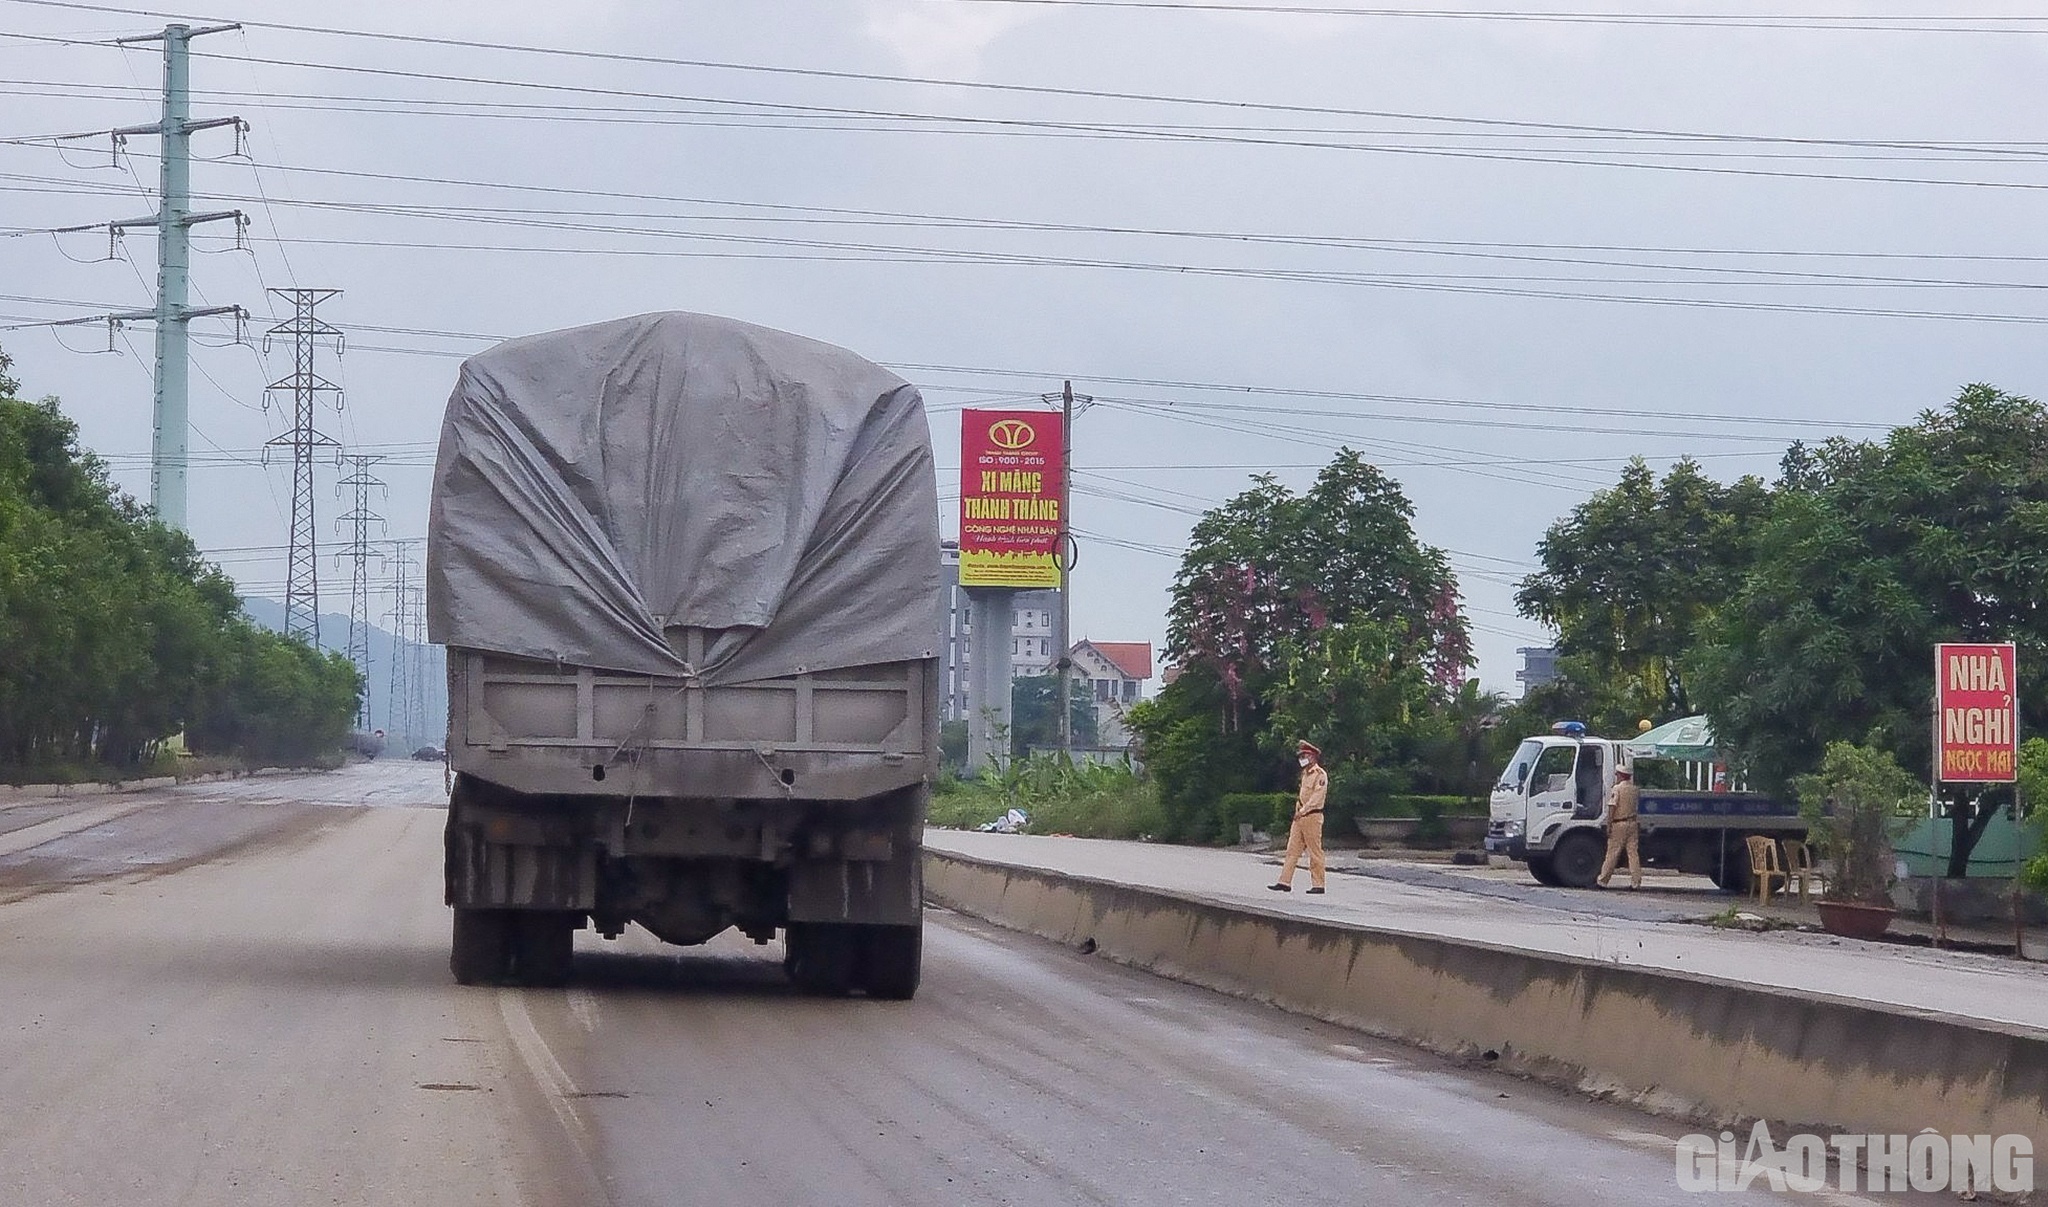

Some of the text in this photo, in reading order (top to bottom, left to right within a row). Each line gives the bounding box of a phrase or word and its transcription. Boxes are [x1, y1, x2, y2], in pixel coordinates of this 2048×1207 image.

[978, 456, 994, 464] ISO
[998, 456, 1019, 465] 9001
[981, 468, 1042, 493] XI MĂNG
[964, 495, 1010, 519] THÀNH
[964, 524, 992, 533] CÔNG
[1950, 648, 2006, 692] NHÀ
[1945, 694, 2012, 745] NGHỈ
[1946, 749, 1983, 778] NGỌC
